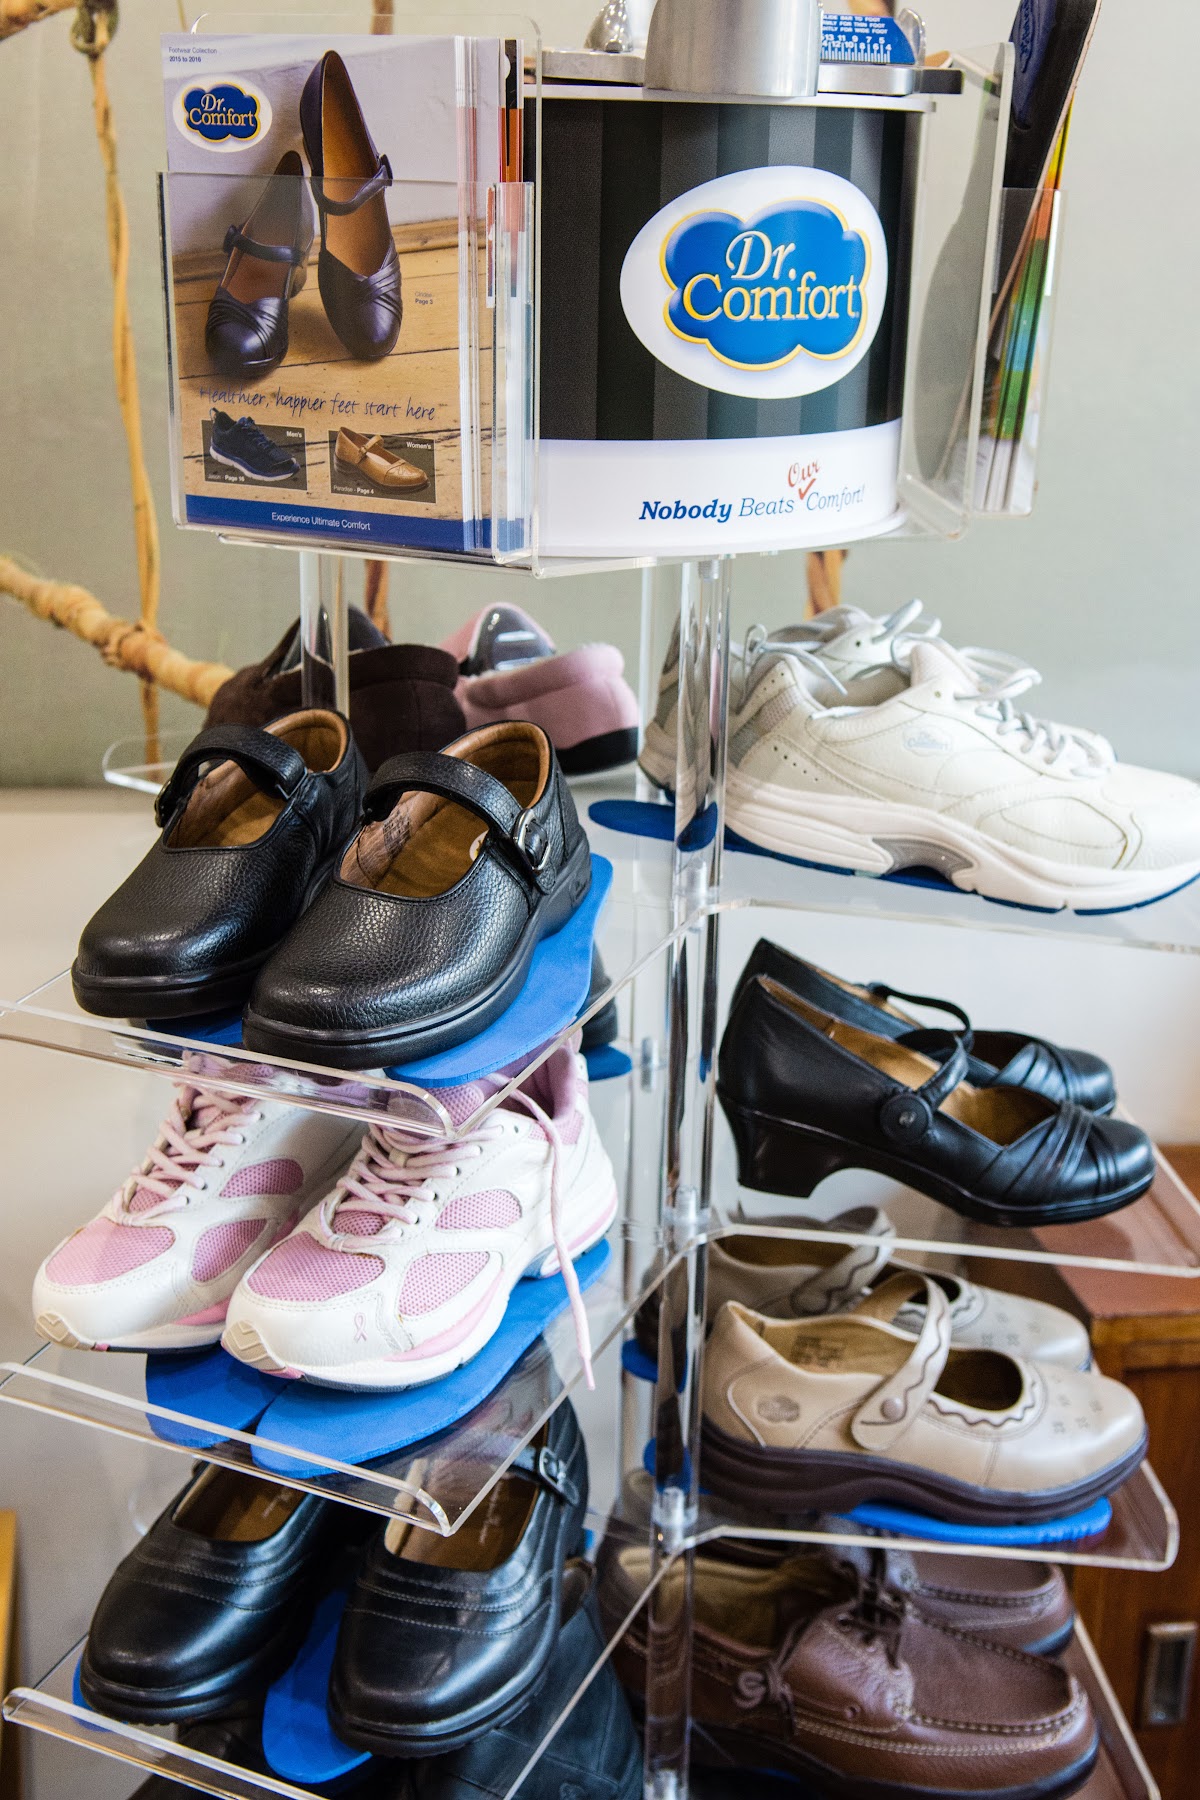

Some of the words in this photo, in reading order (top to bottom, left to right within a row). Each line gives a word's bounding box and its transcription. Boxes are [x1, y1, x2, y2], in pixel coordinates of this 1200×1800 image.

[168, 46, 191, 54] Footwear
[201, 93, 225, 111] Dr.
[189, 107, 255, 126] Comfort
[725, 230, 797, 281] Dr.
[682, 270, 858, 322] Comfort
[199, 384, 269, 409] Healthier,
[275, 386, 327, 418] happier
[331, 392, 360, 415] feet
[364, 401, 402, 418] start
[406, 396, 436, 421] here
[286, 430, 303, 439] Men's
[406, 441, 432, 450] Women's
[224, 474, 238, 482] Page
[787, 459, 821, 488] Our
[356, 487, 370, 495] Page
[638, 498, 733, 524] Nobody
[738, 497, 795, 518] Beats
[806, 483, 865, 514] Comfort!
[271, 511, 311, 525] Experience
[311, 516, 341, 529] Ultimate
[341, 518, 371, 531] Comfort
